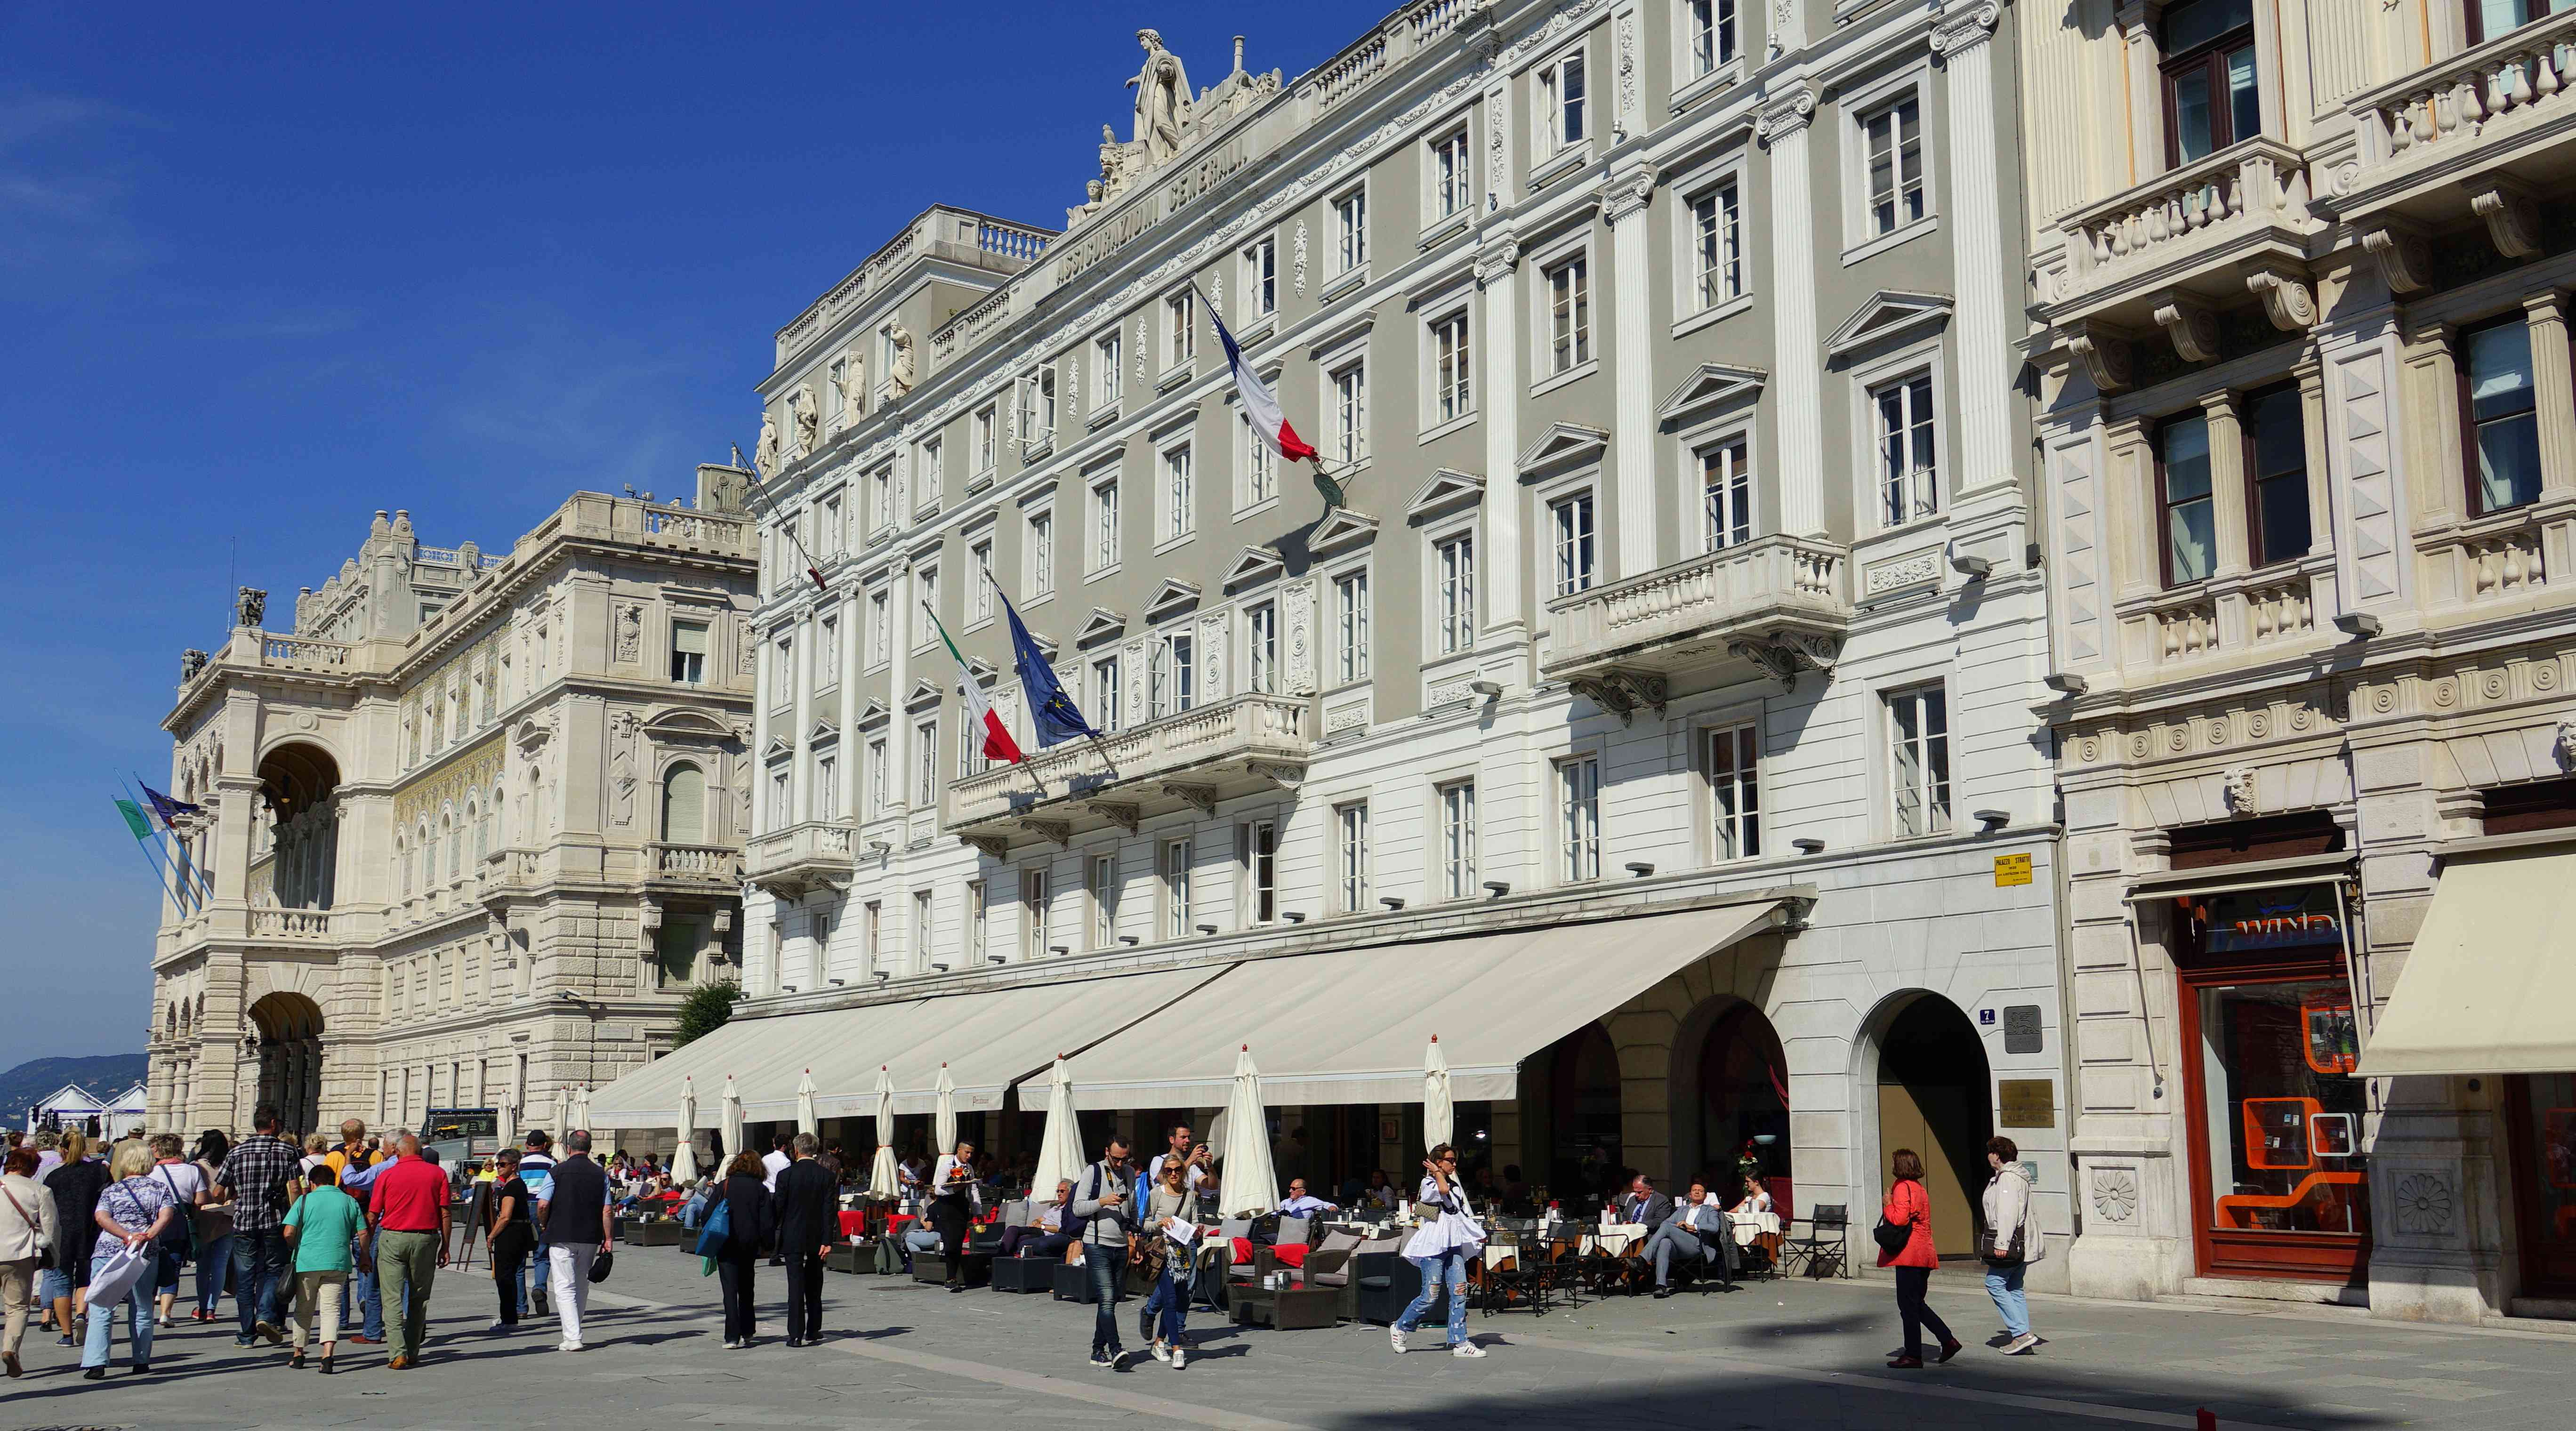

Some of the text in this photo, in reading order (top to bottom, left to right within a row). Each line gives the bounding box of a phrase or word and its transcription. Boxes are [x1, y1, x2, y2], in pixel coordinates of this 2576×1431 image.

[1057, 195, 1159, 287] ASSICURAZIONI
[2236, 912, 2338, 942] WIND
[1984, 1011, 1989, 1020] 7
